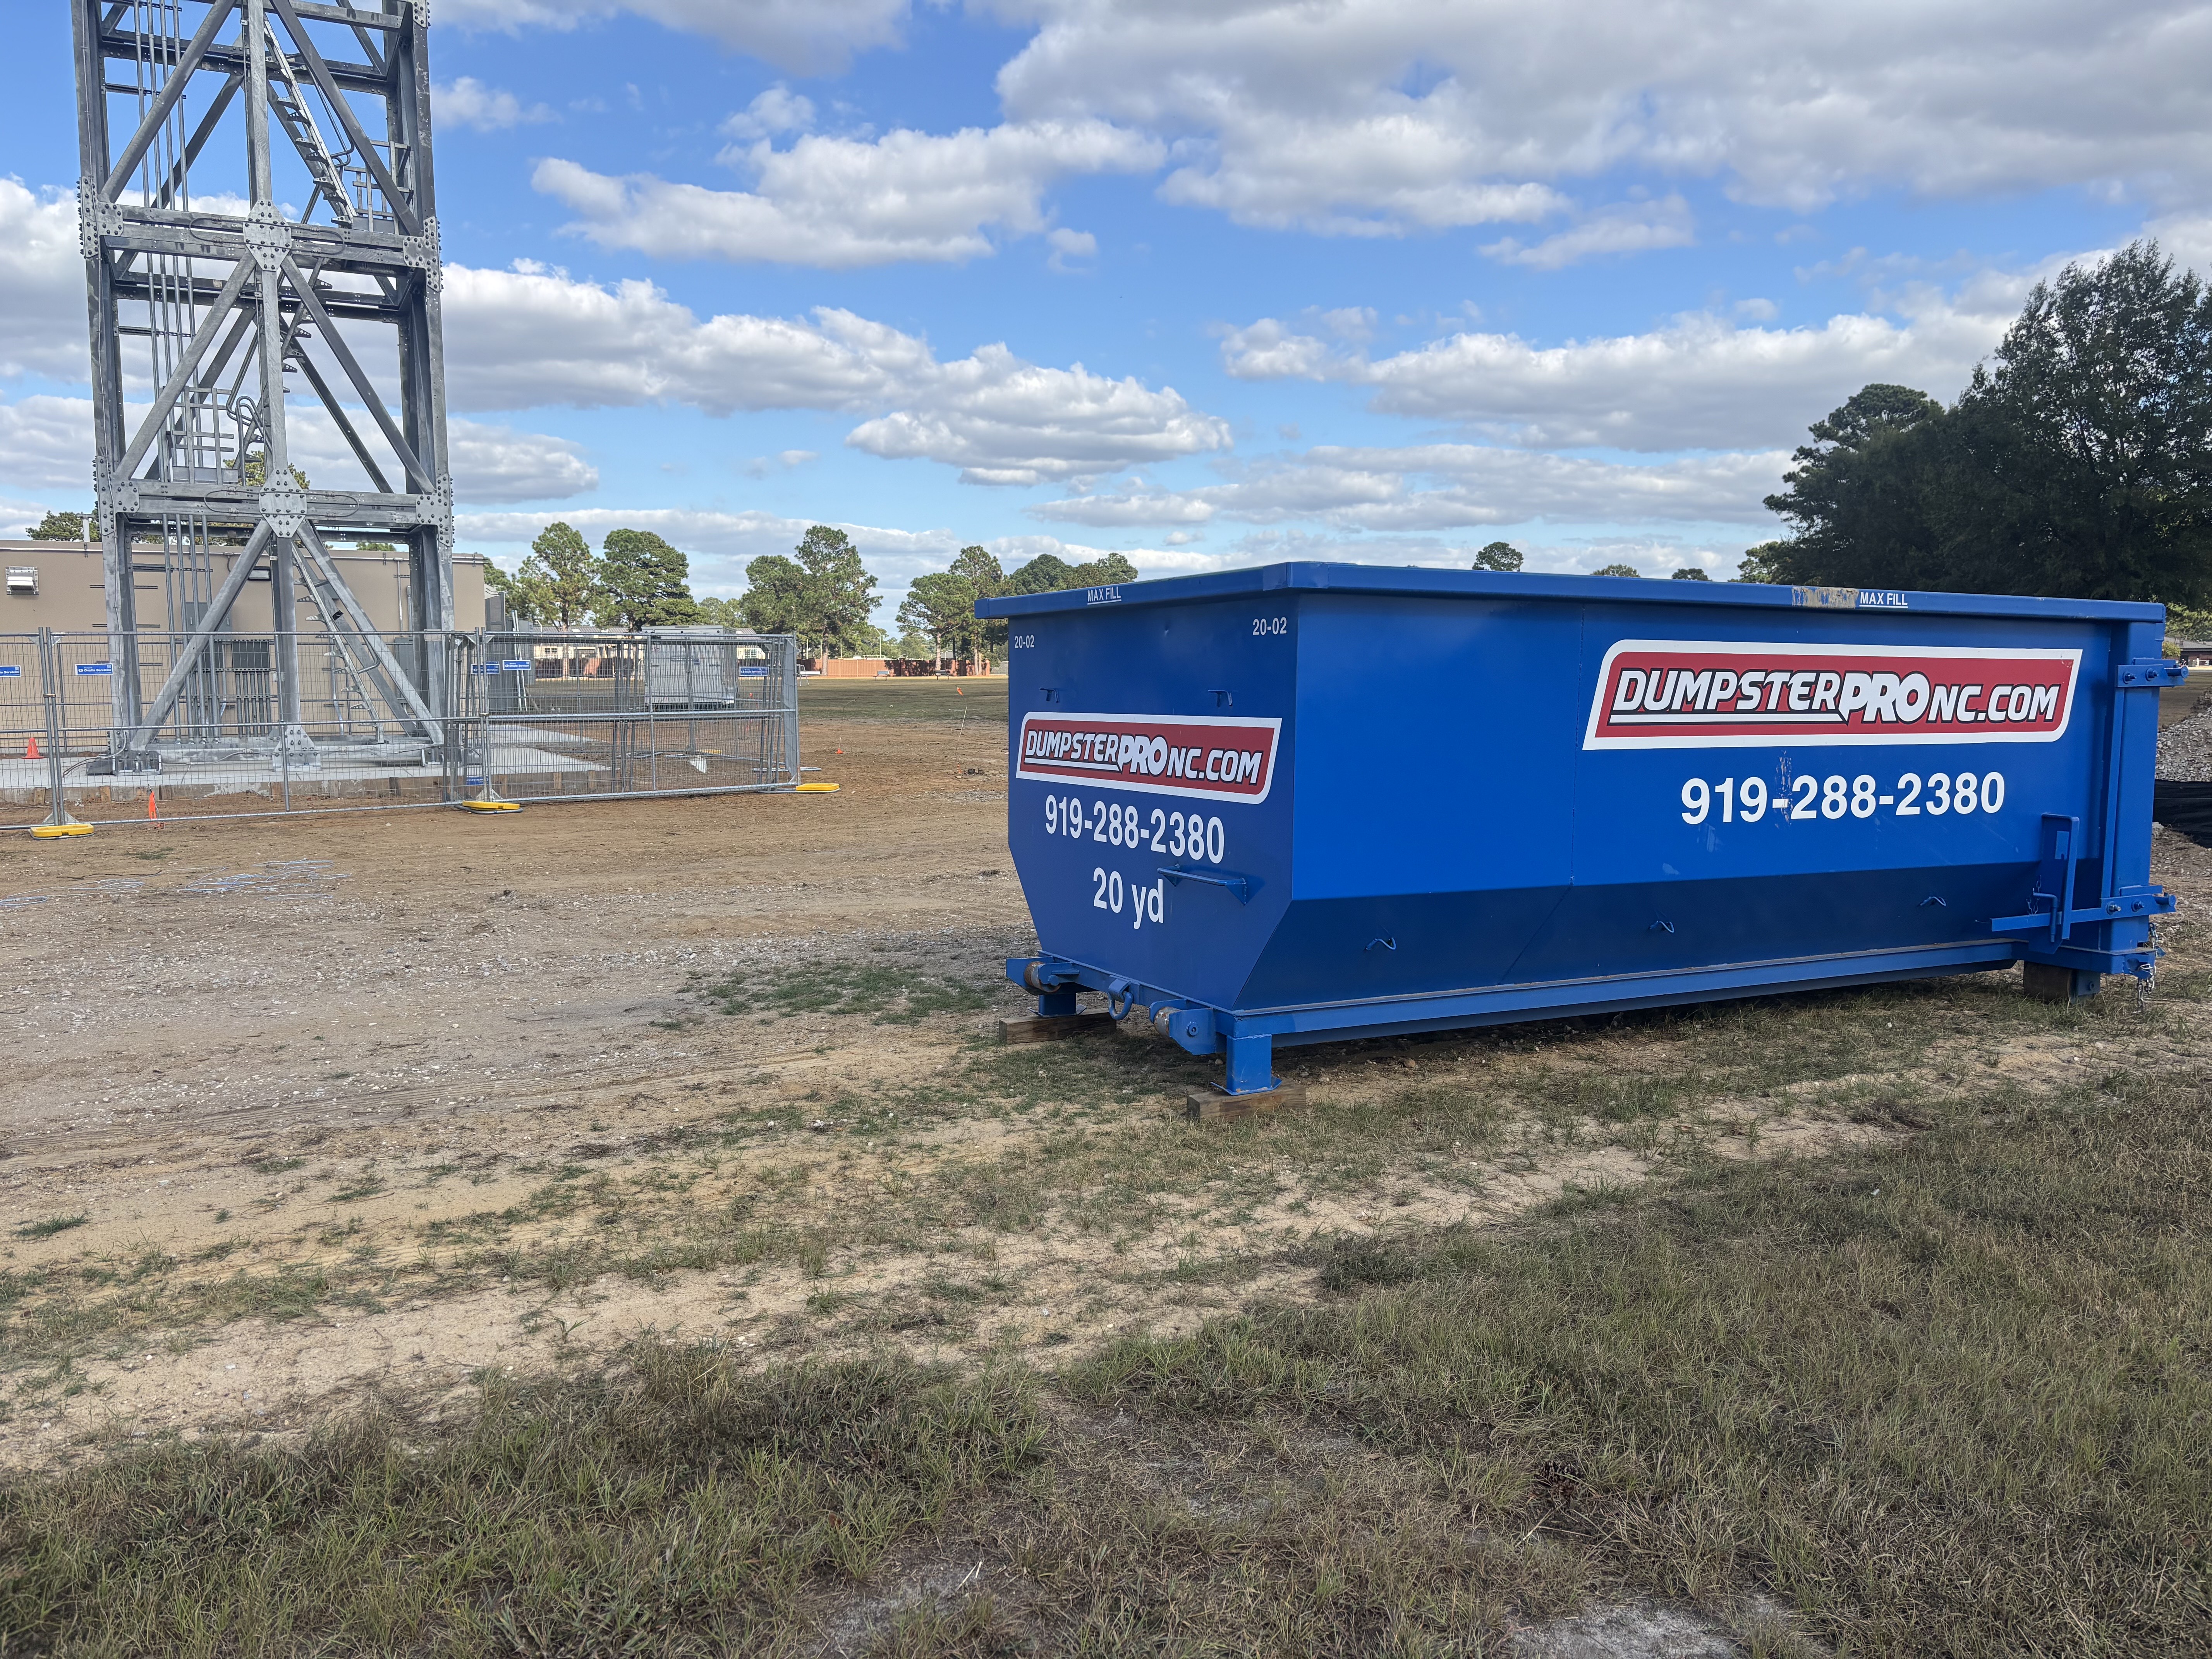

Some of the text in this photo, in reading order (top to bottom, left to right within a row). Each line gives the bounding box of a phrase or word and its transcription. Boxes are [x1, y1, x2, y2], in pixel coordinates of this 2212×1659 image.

[1087, 586, 1121, 602] MAX FILL
[1860, 592, 1908, 605] MAX FILL
[1014, 635, 1035, 649] 20-02
[1252, 617, 1287, 635] 20-02
[1612, 670, 2060, 722] DUMPSTERPRONC.COM
[1024, 730, 1262, 784] DUMPSTERPRONC.COM
[1681, 772, 2005, 825] 919-288-2380
[1045, 794, 1224, 864] 919-288-2380
[1093, 867, 1164, 930] 20 yd
